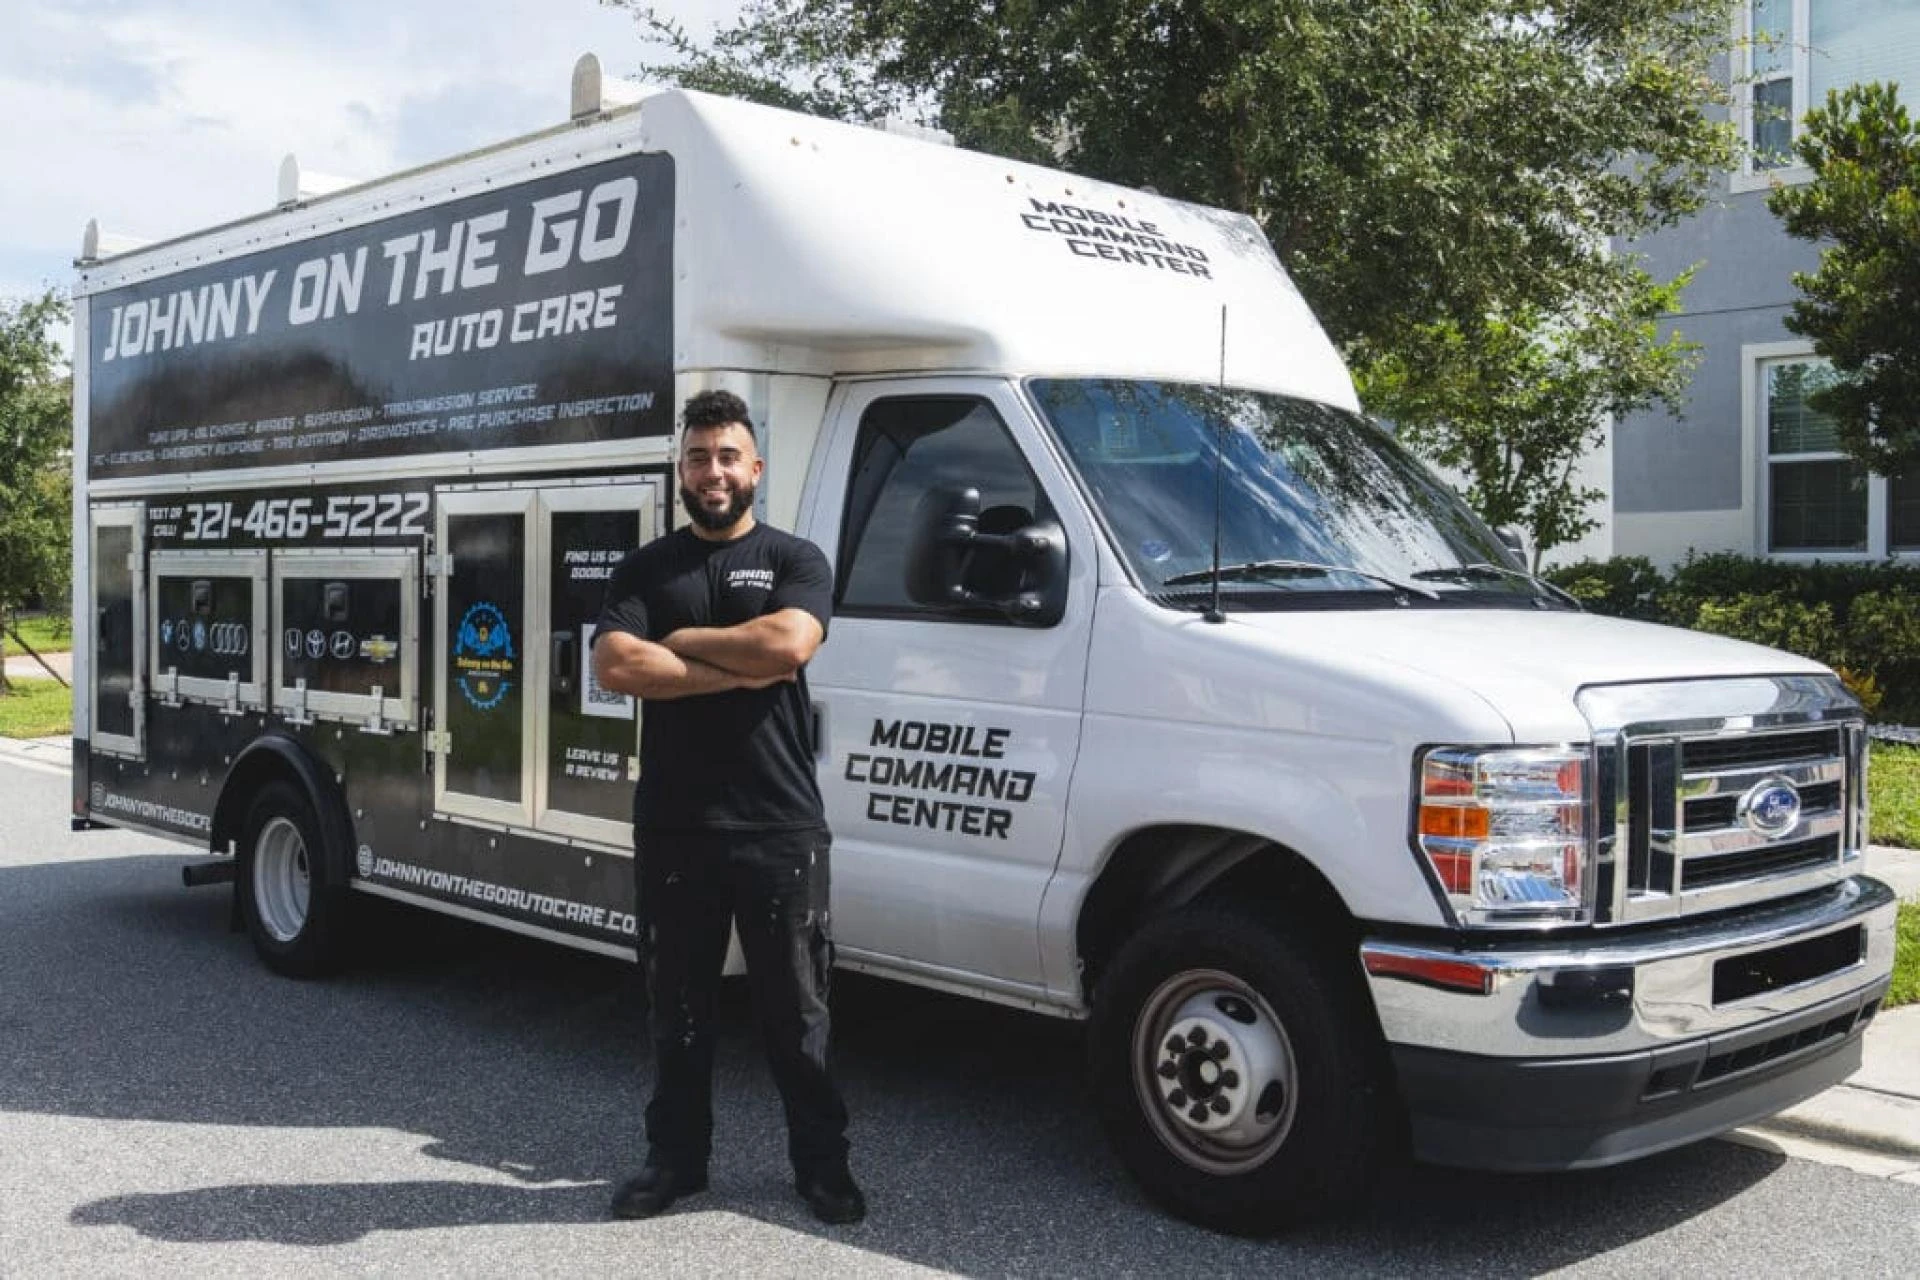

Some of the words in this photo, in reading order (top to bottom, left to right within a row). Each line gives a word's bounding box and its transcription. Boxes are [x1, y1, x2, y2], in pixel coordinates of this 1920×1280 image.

[1020, 213, 1209, 263] COMMAND
[1029, 198, 1164, 236] MOBILE
[104, 269, 275, 361] JOHNNY
[289, 247, 367, 326] ON
[382, 209, 508, 306] THE
[525, 176, 638, 276] GO
[1066, 238, 1213, 279] CENTER
[409, 309, 503, 361] AUTO
[510, 284, 624, 344] CARE
[358, 419, 438, 441] DIAGNOSTICS
[447, 413, 476, 430] PRE
[477, 404, 556, 429] PURCHASE
[558, 392, 655, 420] INSPECTION
[384, 393, 475, 418] TRANSMISSION
[478, 384, 537, 405] SERVICE
[184, 492, 430, 540] 321-466-5222
[564, 550, 589, 563] FIND
[591, 550, 606, 563] US
[566, 748, 600, 762] LEAVE
[602, 750, 618, 765] US
[870, 718, 1011, 759] MOBILE
[577, 765, 618, 781] REVIEW
[844, 753, 1036, 803] COMMAND
[868, 792, 1012, 840] CENTER
[373, 857, 637, 935] JOHNNYONTHEGOAUTOCARE.CO
